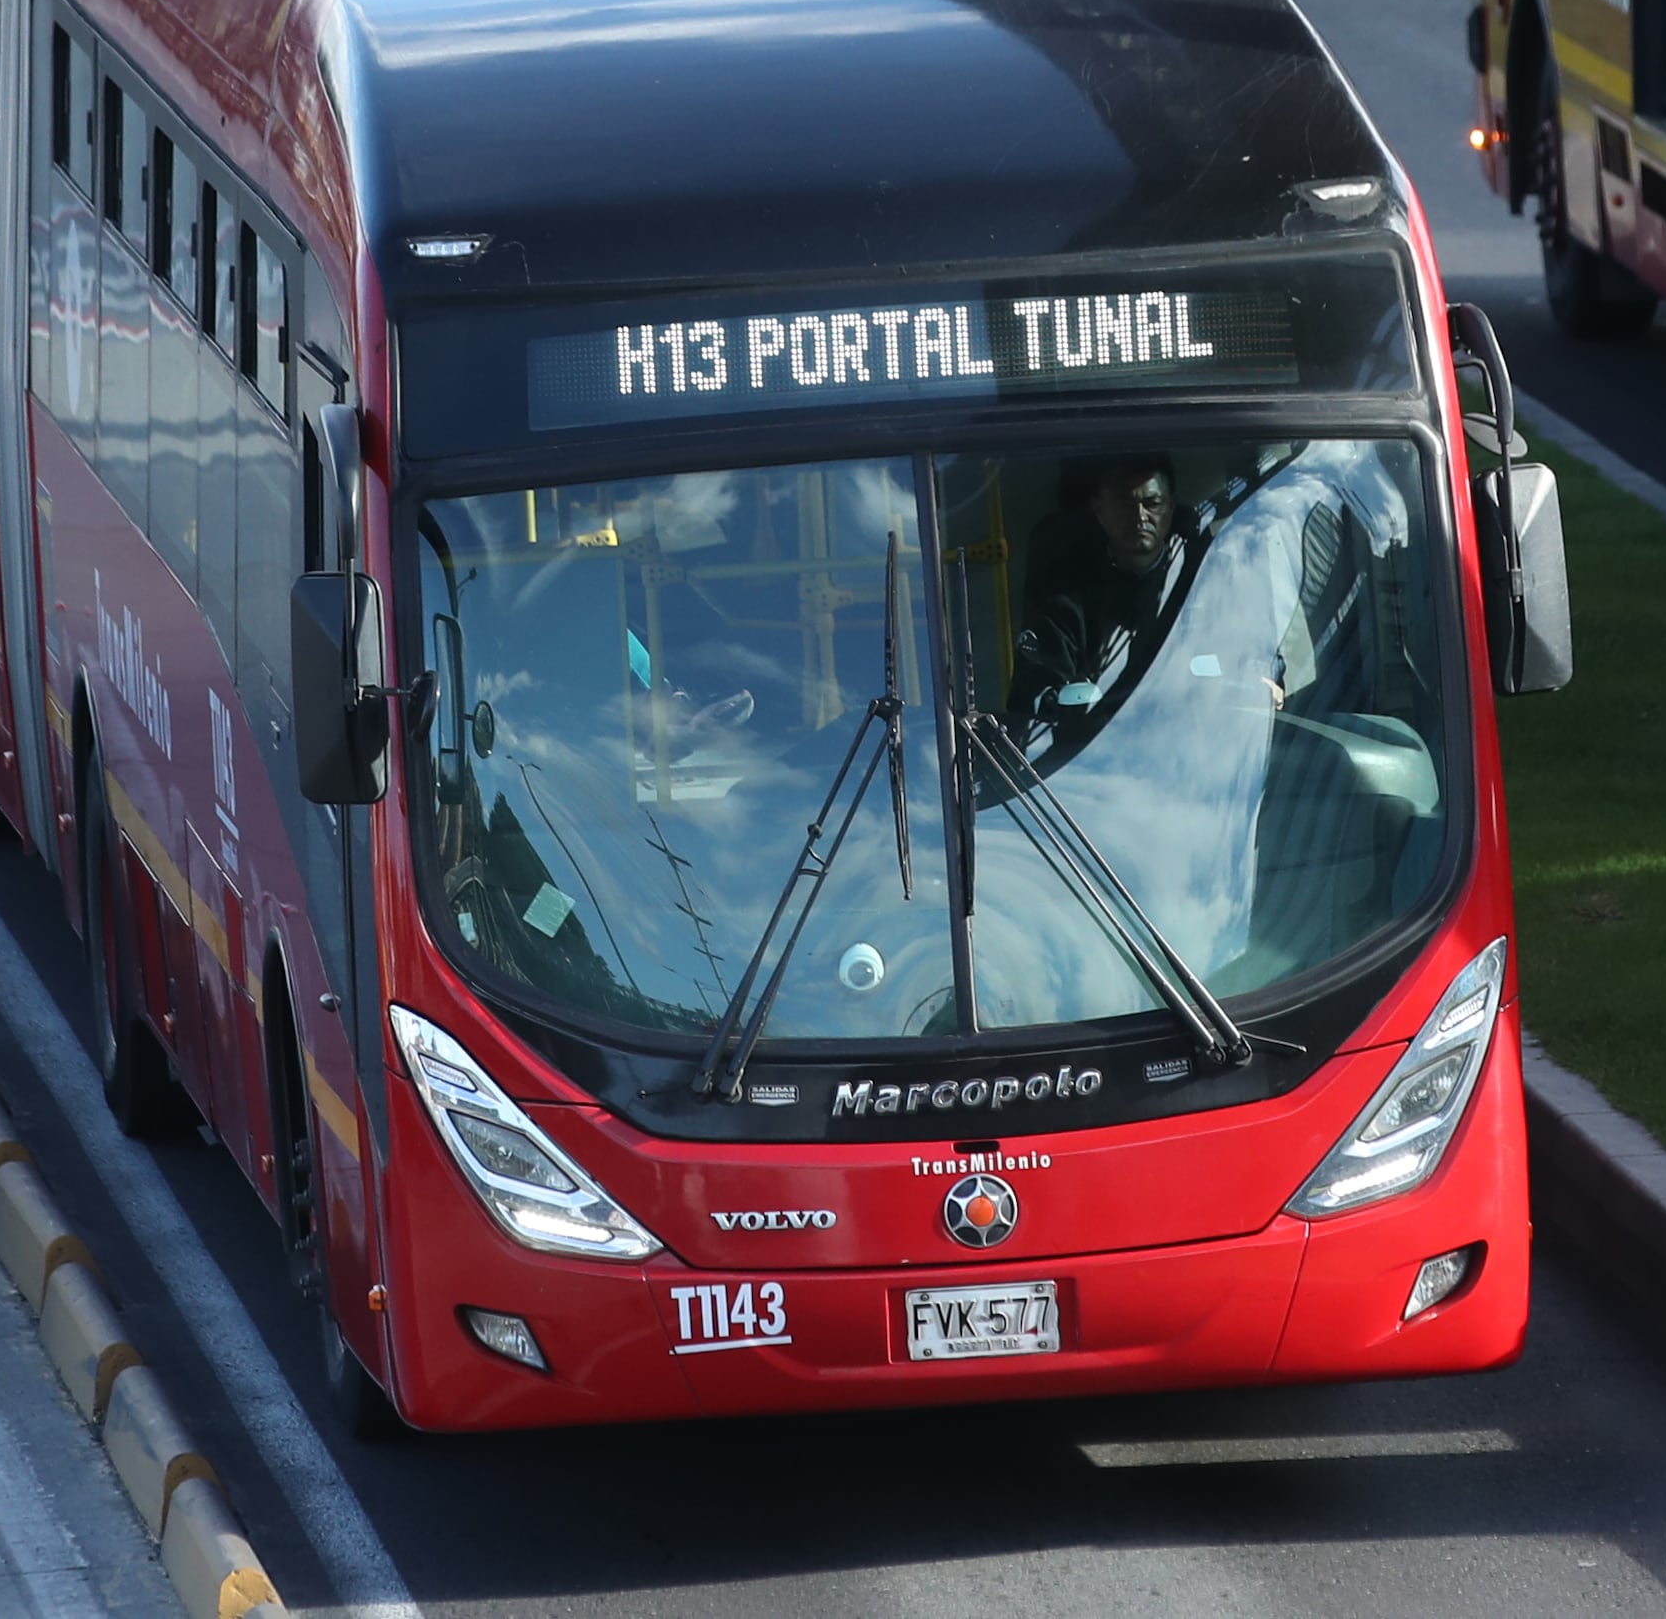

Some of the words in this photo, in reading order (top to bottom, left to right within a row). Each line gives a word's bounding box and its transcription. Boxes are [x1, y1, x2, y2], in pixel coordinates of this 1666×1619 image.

[616, 321, 726, 395] H13
[747, 305, 995, 389] PORTAL
[1012, 290, 1214, 372] TUNAL
[1146, 1059, 1188, 1072] SALIDAS
[832, 1064, 1103, 1118] Marcopolo
[911, 1150, 1053, 1177] TransMilenio
[710, 1210, 837, 1231] VOLVO
[670, 1281, 787, 1340] T1143
